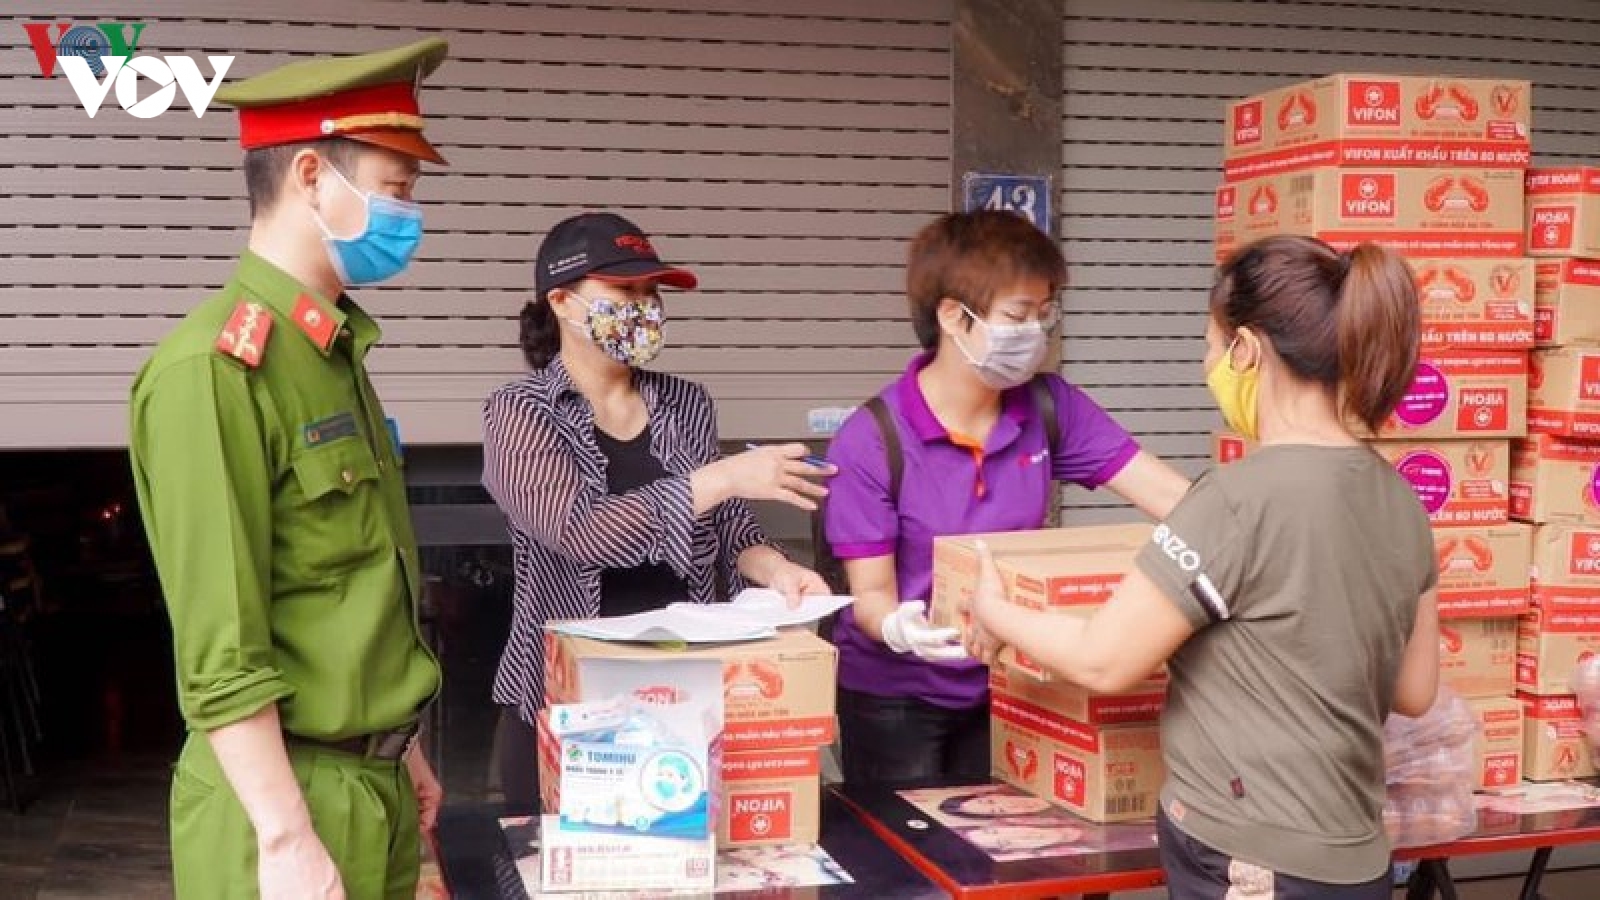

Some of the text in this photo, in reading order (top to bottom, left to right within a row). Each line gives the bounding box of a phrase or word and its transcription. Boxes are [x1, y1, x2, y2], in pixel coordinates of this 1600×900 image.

[1353, 107, 1397, 121] VIFON
[1344, 147, 1380, 160] VIFON
[1346, 200, 1391, 214] VIFON
[736, 799, 785, 813] VIFON
